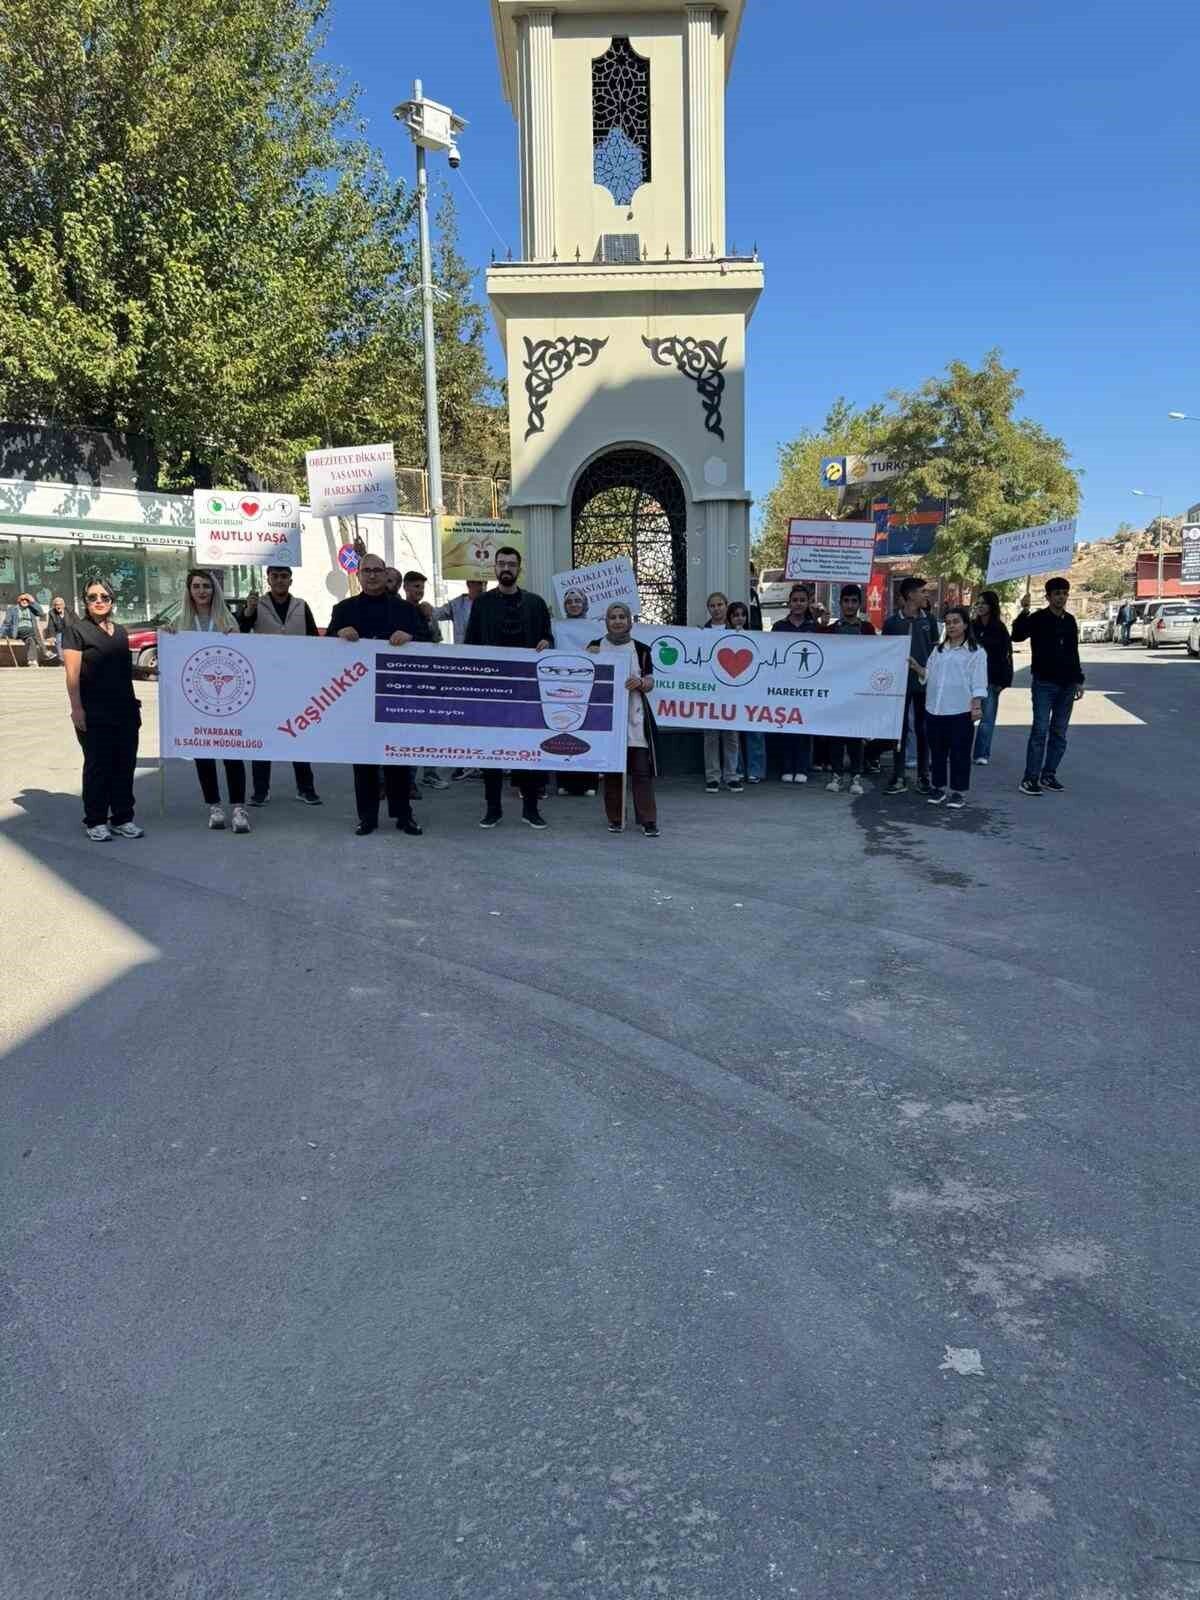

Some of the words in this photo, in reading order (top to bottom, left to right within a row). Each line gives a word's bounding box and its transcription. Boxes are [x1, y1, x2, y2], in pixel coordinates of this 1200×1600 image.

[210, 530, 253, 542] MUTLU
[257, 532, 288, 545] YAŞA
[678, 681, 717, 691] BESLEN
[767, 687, 814, 698] HAREKET
[816, 689, 829, 698] ET
[277, 661, 370, 739] Yaşlılıkta
[657, 699, 737, 721] MUTLU
[744, 704, 803, 729] YAŞA
[194, 727, 243, 736] DİYARBAKIR
[174, 737, 181, 746] İL
[183, 736, 211, 747] SAĞLIK
[213, 737, 264, 749] MÜDÜRLÜĞÜ
